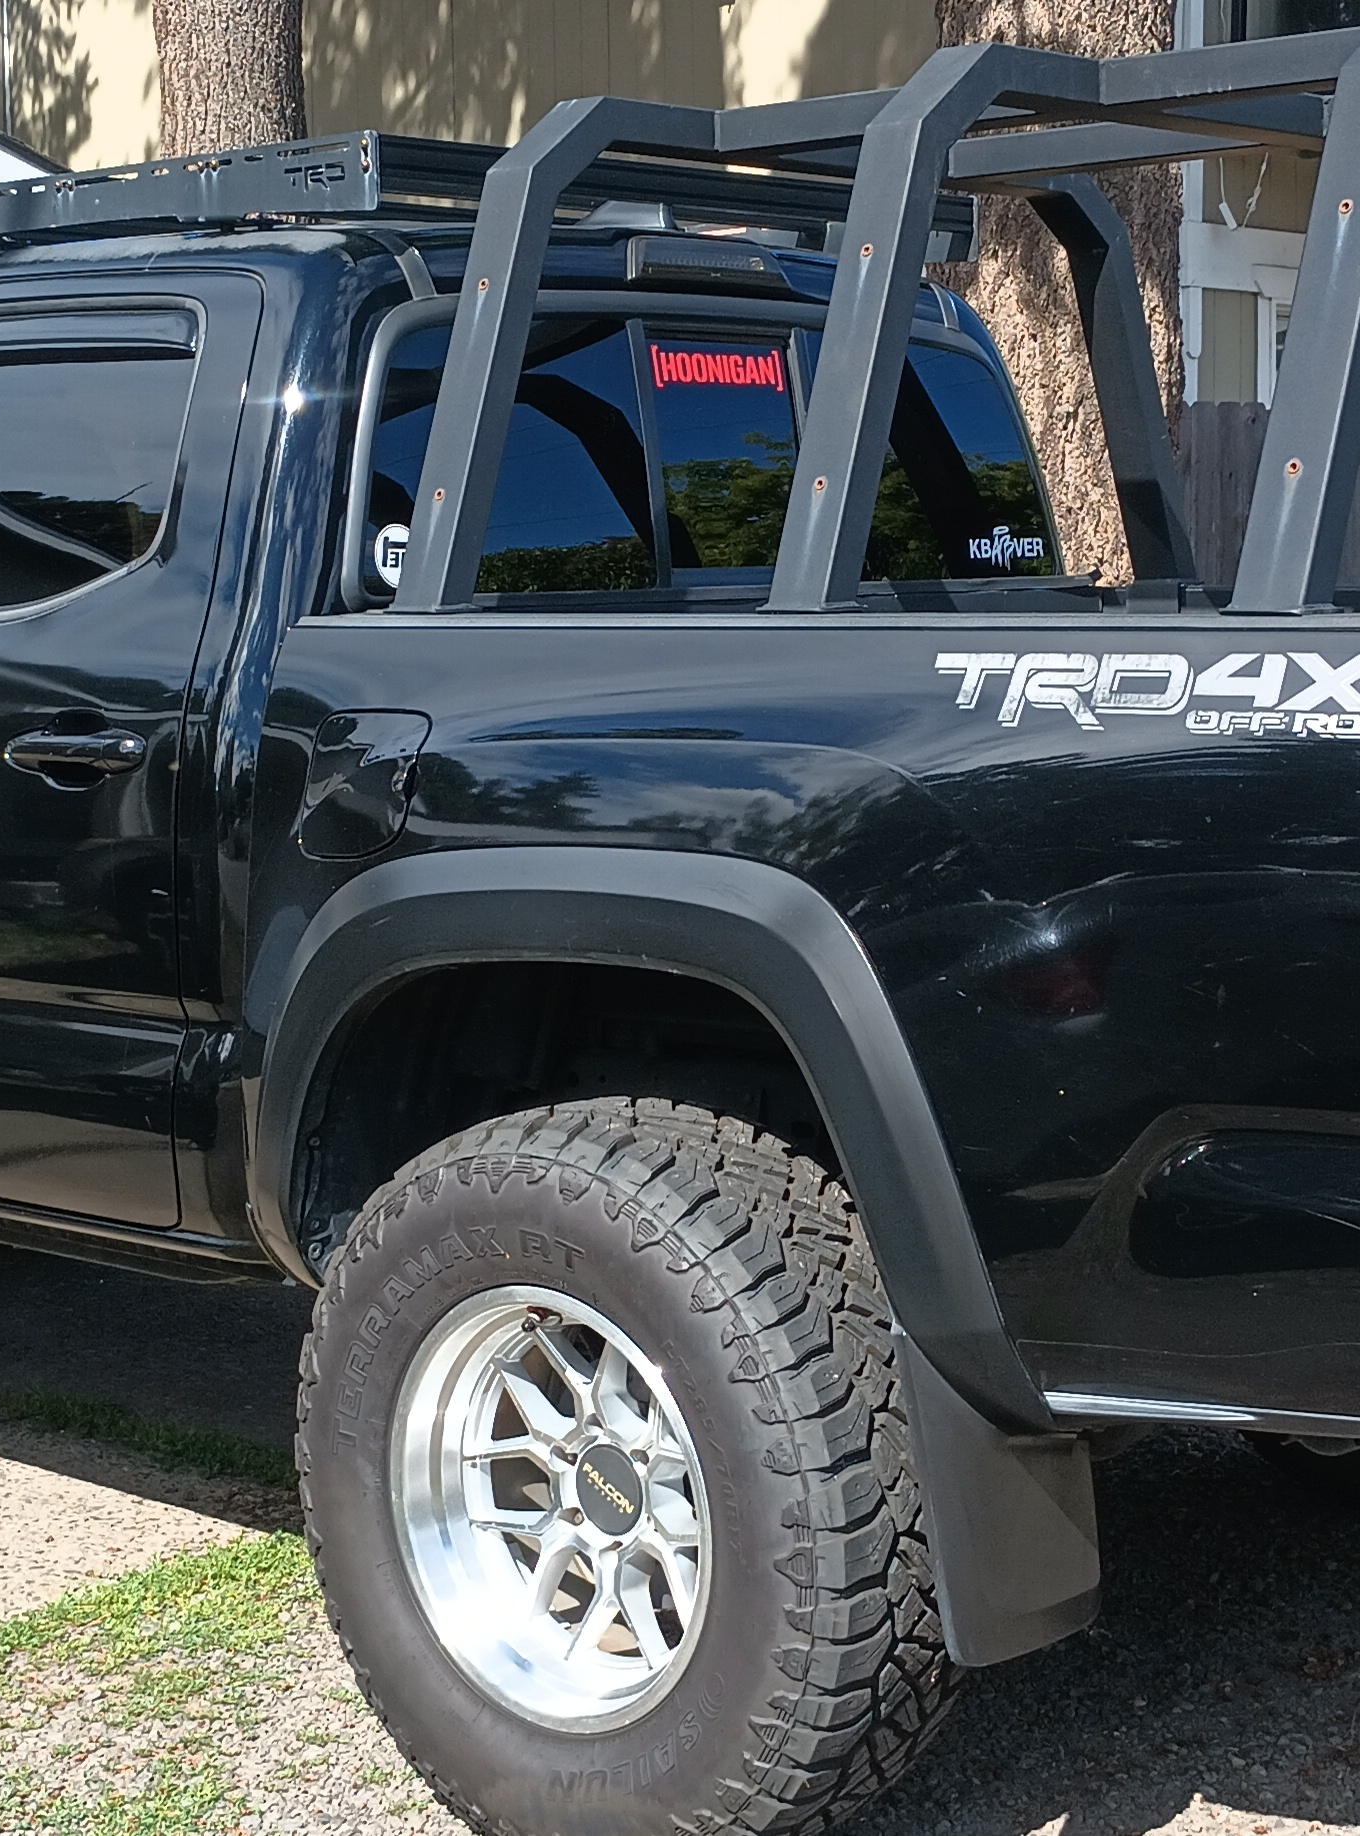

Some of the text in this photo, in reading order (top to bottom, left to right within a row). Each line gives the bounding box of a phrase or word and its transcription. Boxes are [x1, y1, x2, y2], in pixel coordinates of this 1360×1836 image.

[284, 161, 346, 193] TRD
[934, 652, 1194, 731] TRD
[1186, 710, 1290, 737] OFF
[332, 1225, 506, 1455] TERRAMAX
[582, 1462, 635, 1514] FALCON
[546, 1709, 703, 1803] SAILUN
